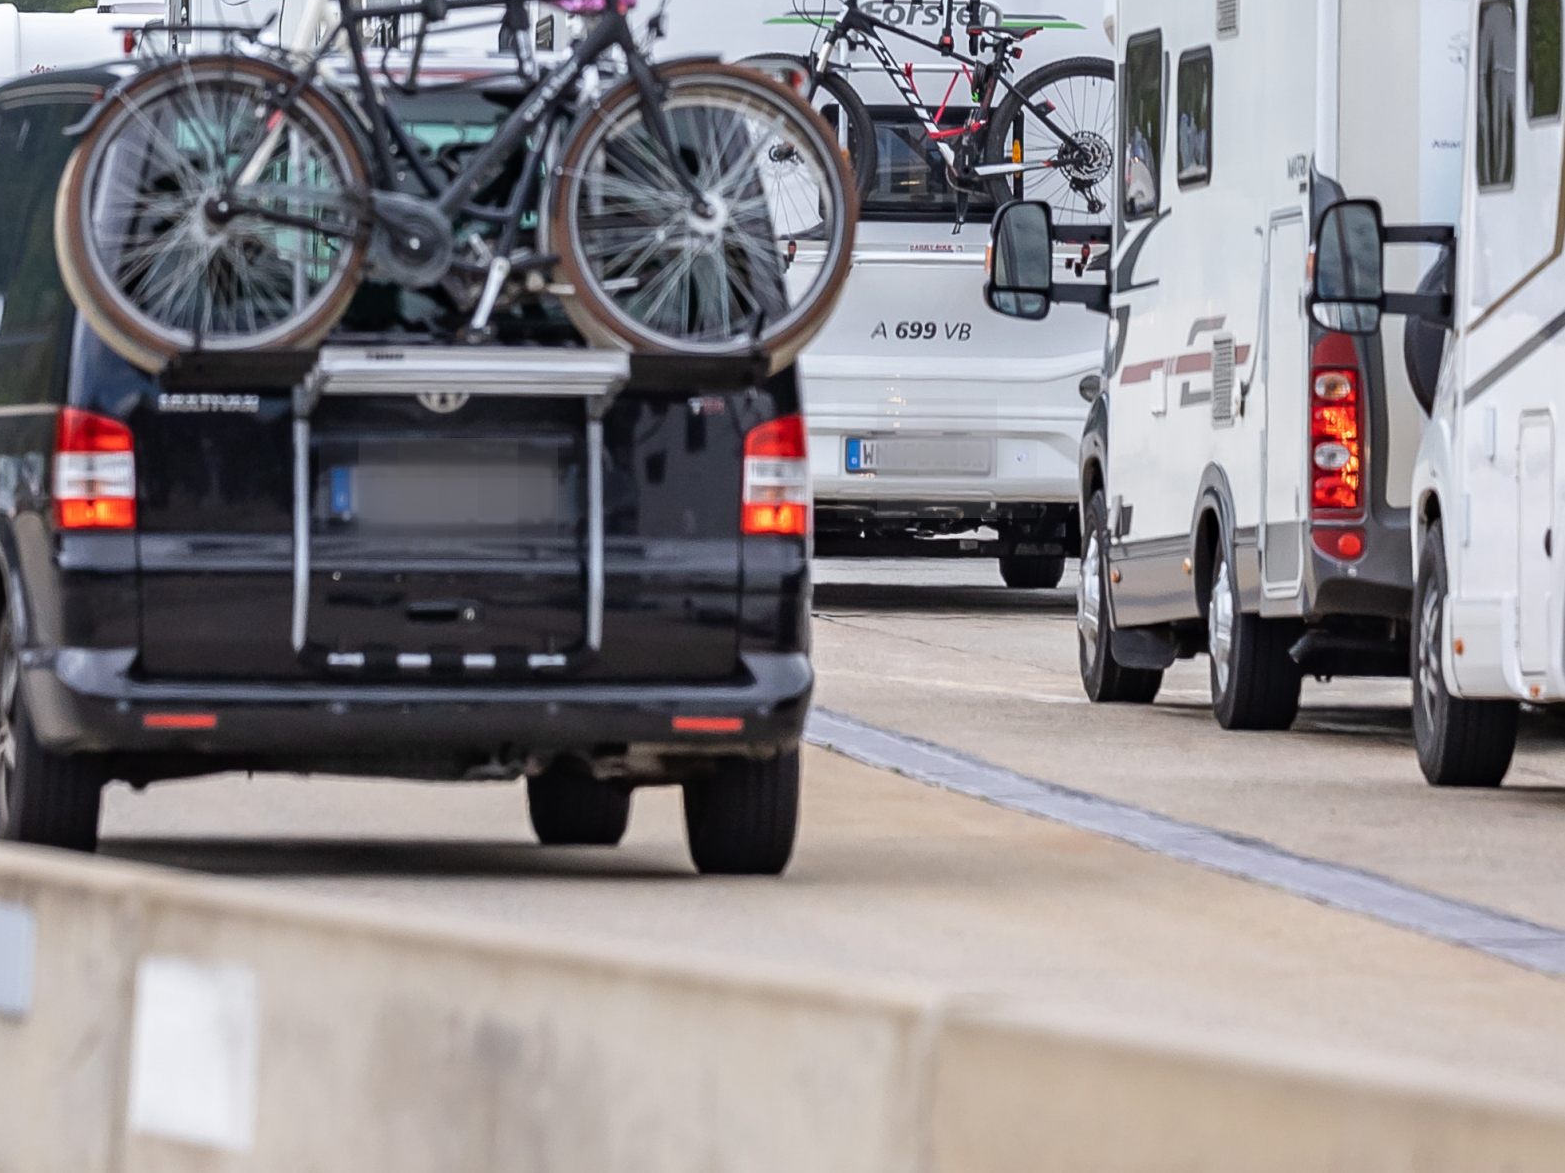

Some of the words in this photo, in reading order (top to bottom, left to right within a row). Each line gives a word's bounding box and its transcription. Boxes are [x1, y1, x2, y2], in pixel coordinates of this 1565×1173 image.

[870, 320, 887, 340] A
[895, 320, 937, 340] 699
[944, 321, 972, 342] VB
